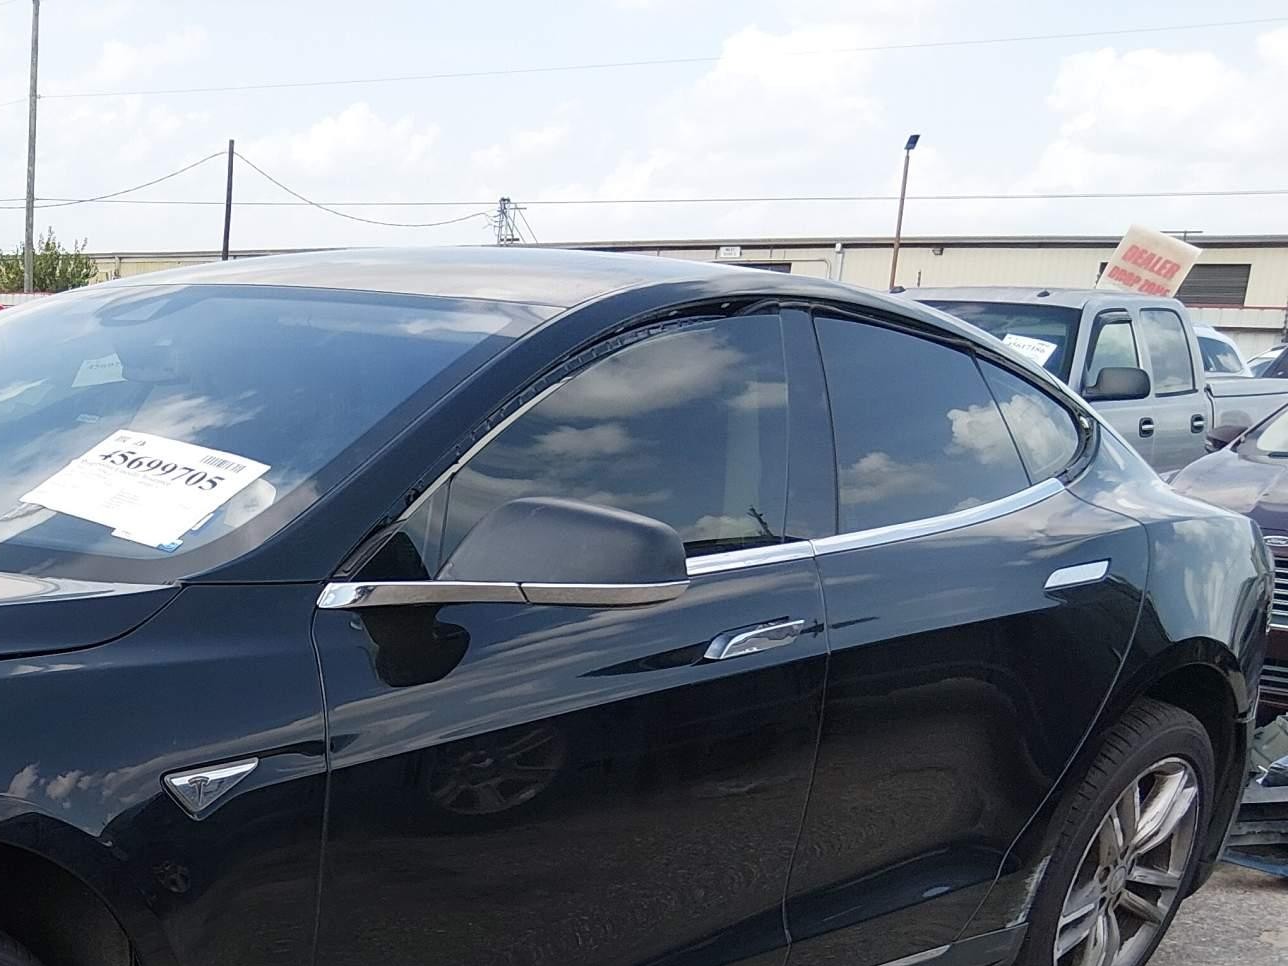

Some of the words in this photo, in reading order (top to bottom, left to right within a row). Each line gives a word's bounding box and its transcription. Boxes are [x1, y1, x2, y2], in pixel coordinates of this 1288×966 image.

[1107, 265, 1142, 288] DROP
[1121, 244, 1181, 280] DEALER
[99, 450, 225, 491] 45699705
